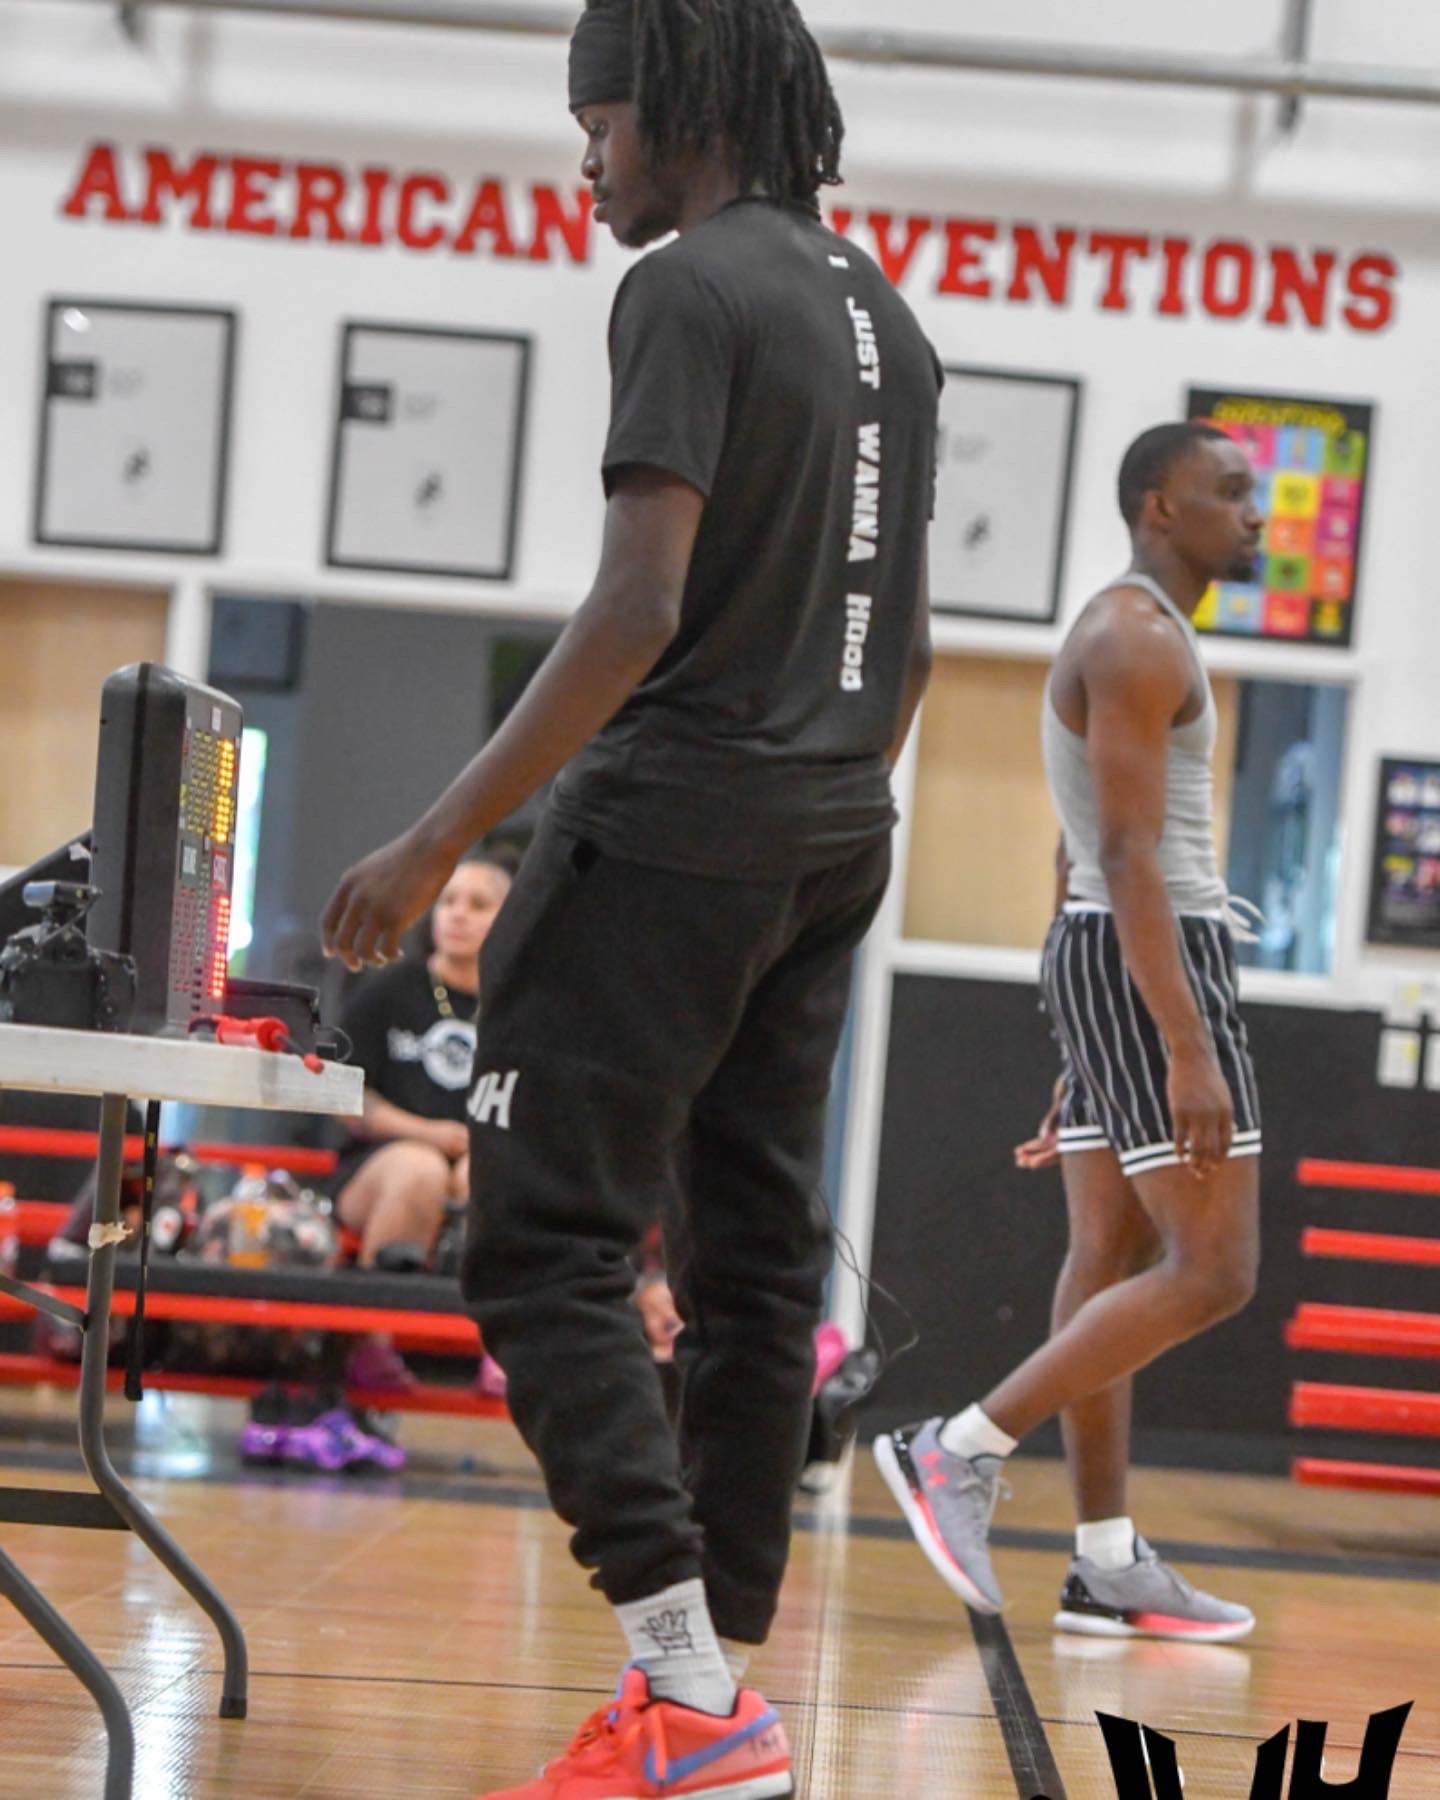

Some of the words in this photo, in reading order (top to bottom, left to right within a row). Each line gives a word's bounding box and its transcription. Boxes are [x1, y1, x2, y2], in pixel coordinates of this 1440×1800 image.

[60, 142, 594, 266] AMERICAN
[831, 207, 1400, 333] VENTIONS
[846, 296, 880, 390] JUST
[847, 422, 880, 563] WANNA
